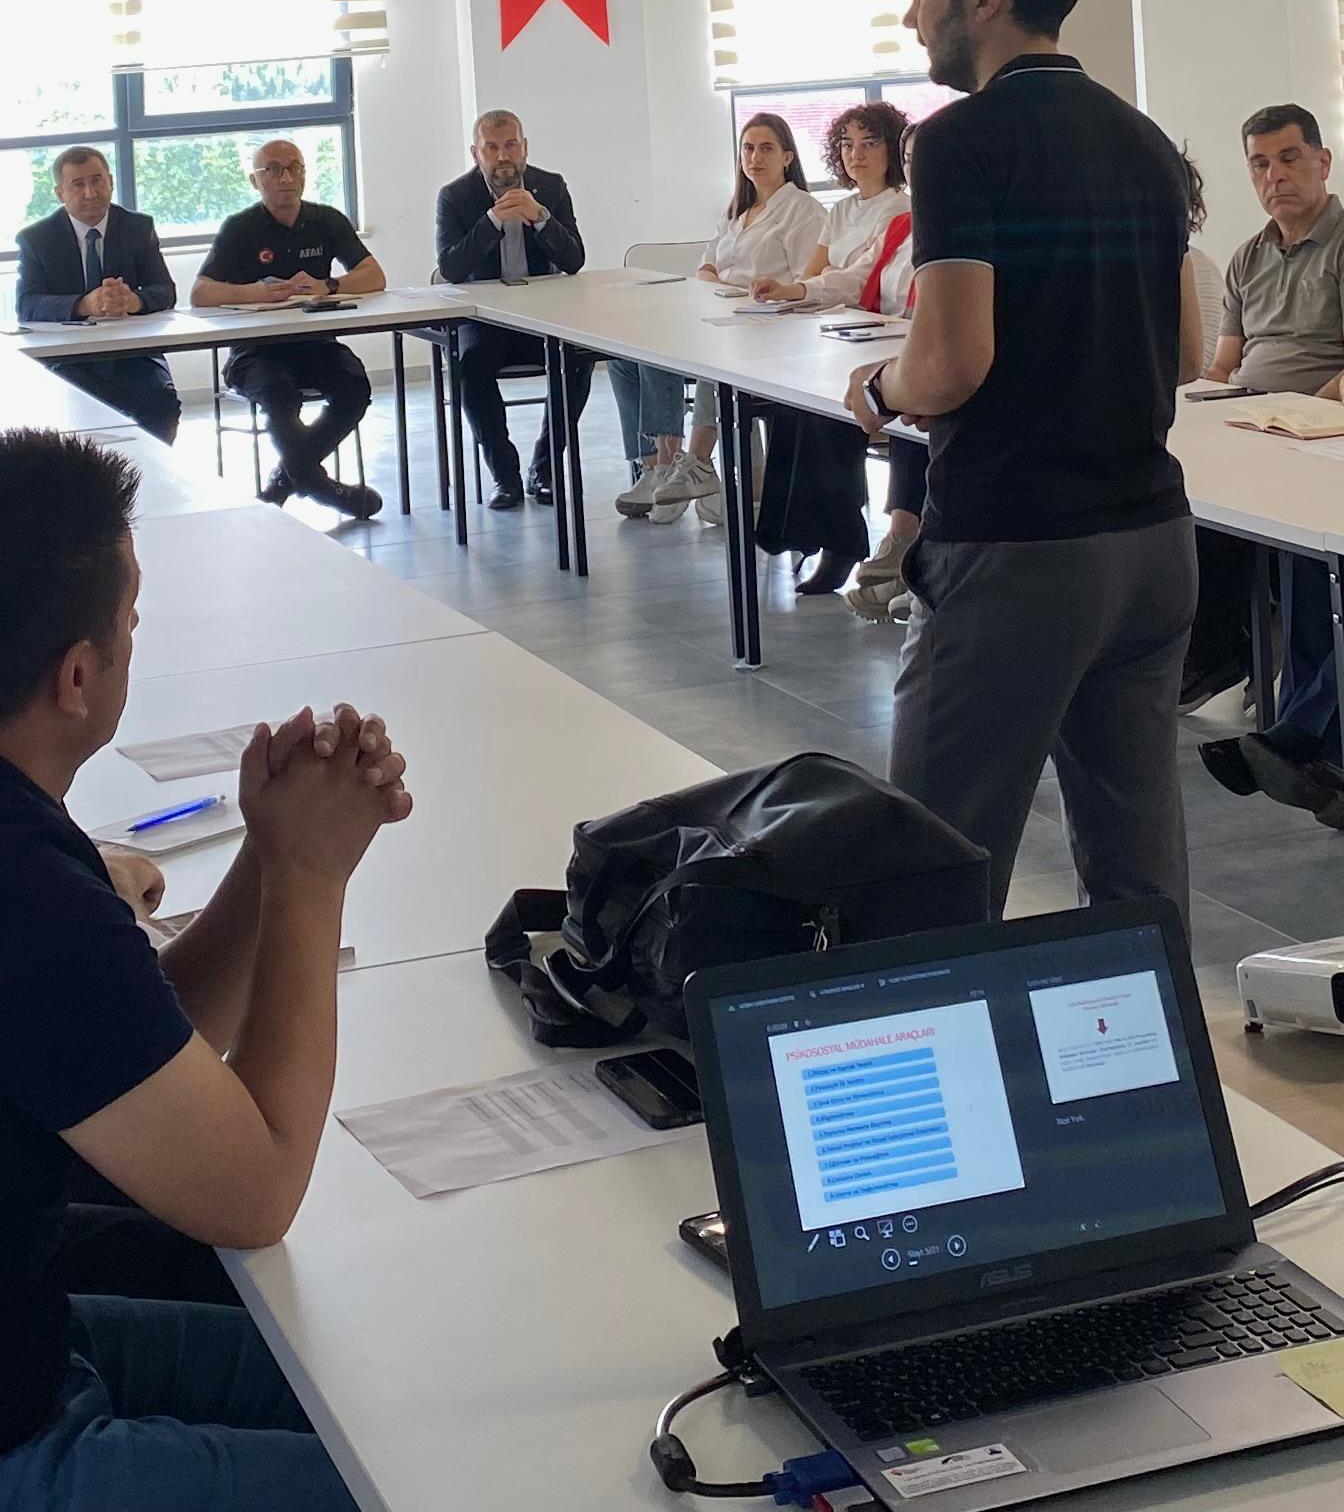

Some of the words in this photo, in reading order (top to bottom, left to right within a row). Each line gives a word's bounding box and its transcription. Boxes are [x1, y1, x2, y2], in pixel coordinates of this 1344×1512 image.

[786, 1042, 844, 1062] PSİKOSOSYAL
[845, 1035, 894, 1052] MÜDAHALE
[895, 1027, 936, 1043] ARAÇLARI
